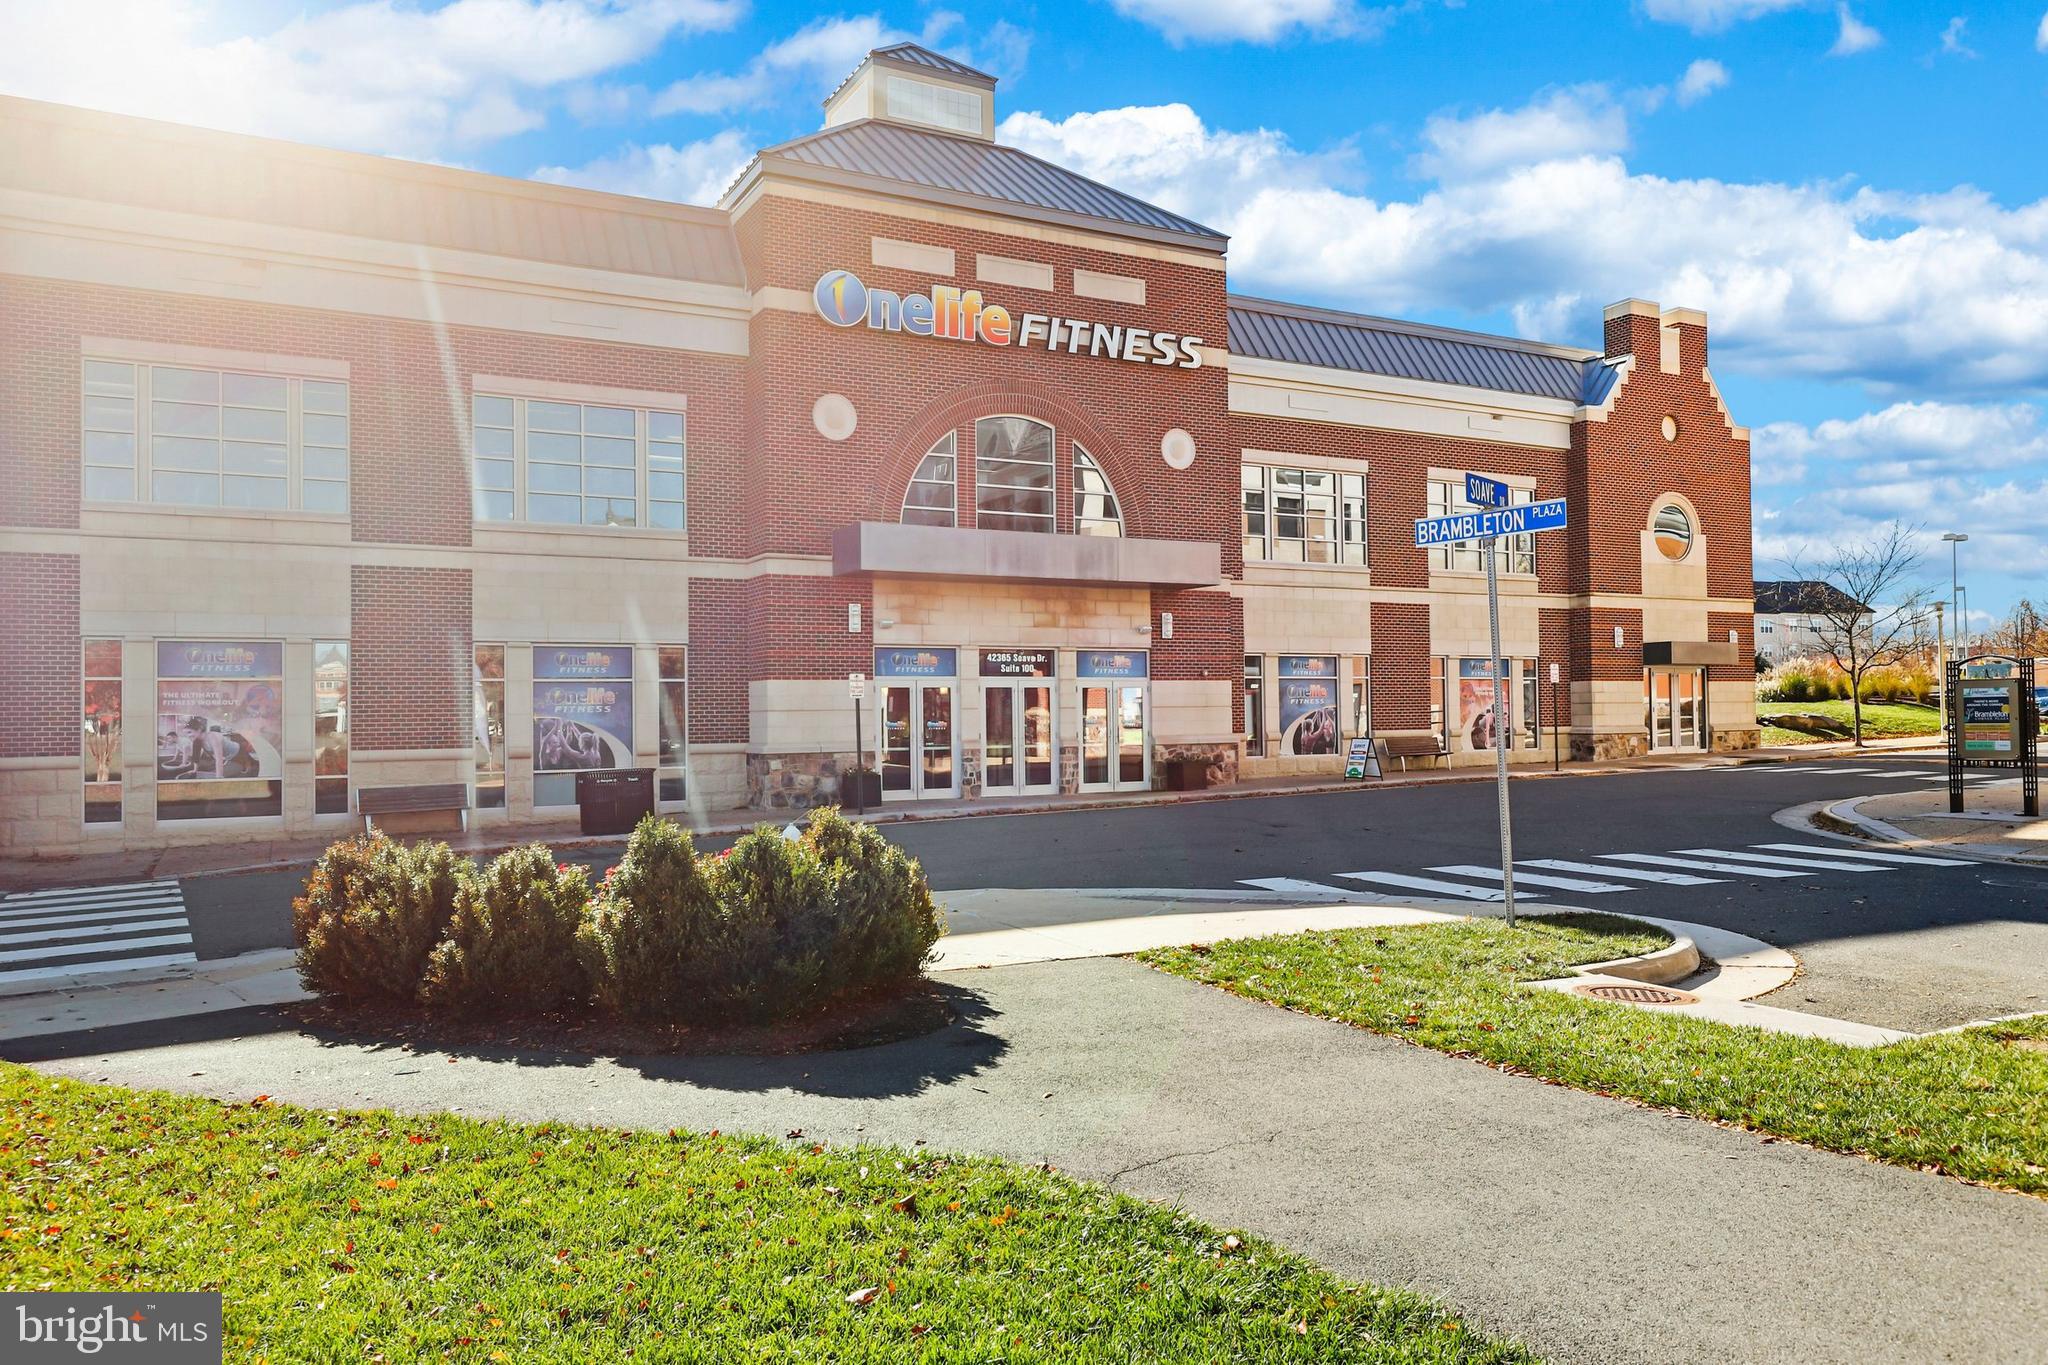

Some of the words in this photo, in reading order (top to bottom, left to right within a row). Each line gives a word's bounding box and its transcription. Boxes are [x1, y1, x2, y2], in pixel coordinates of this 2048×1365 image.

[813, 269, 1012, 346] Onelife
[1018, 312, 1204, 370] FITNESS
[1470, 477, 1495, 504] SOAVE
[1418, 508, 1525, 544] BRAMBLETON
[1532, 503, 1563, 519] PLAZA
[986, 653, 1012, 662] 42365
[1013, 653, 1036, 662] Soave
[1037, 654, 1048, 662] Dr.
[191, 664, 251, 672] FITNESS
[1000, 663, 1020, 673] Suite
[1021, 663, 1035, 673] 100
[1094, 667, 1129, 675] FITNESS
[554, 705, 612, 713] FITNESS
